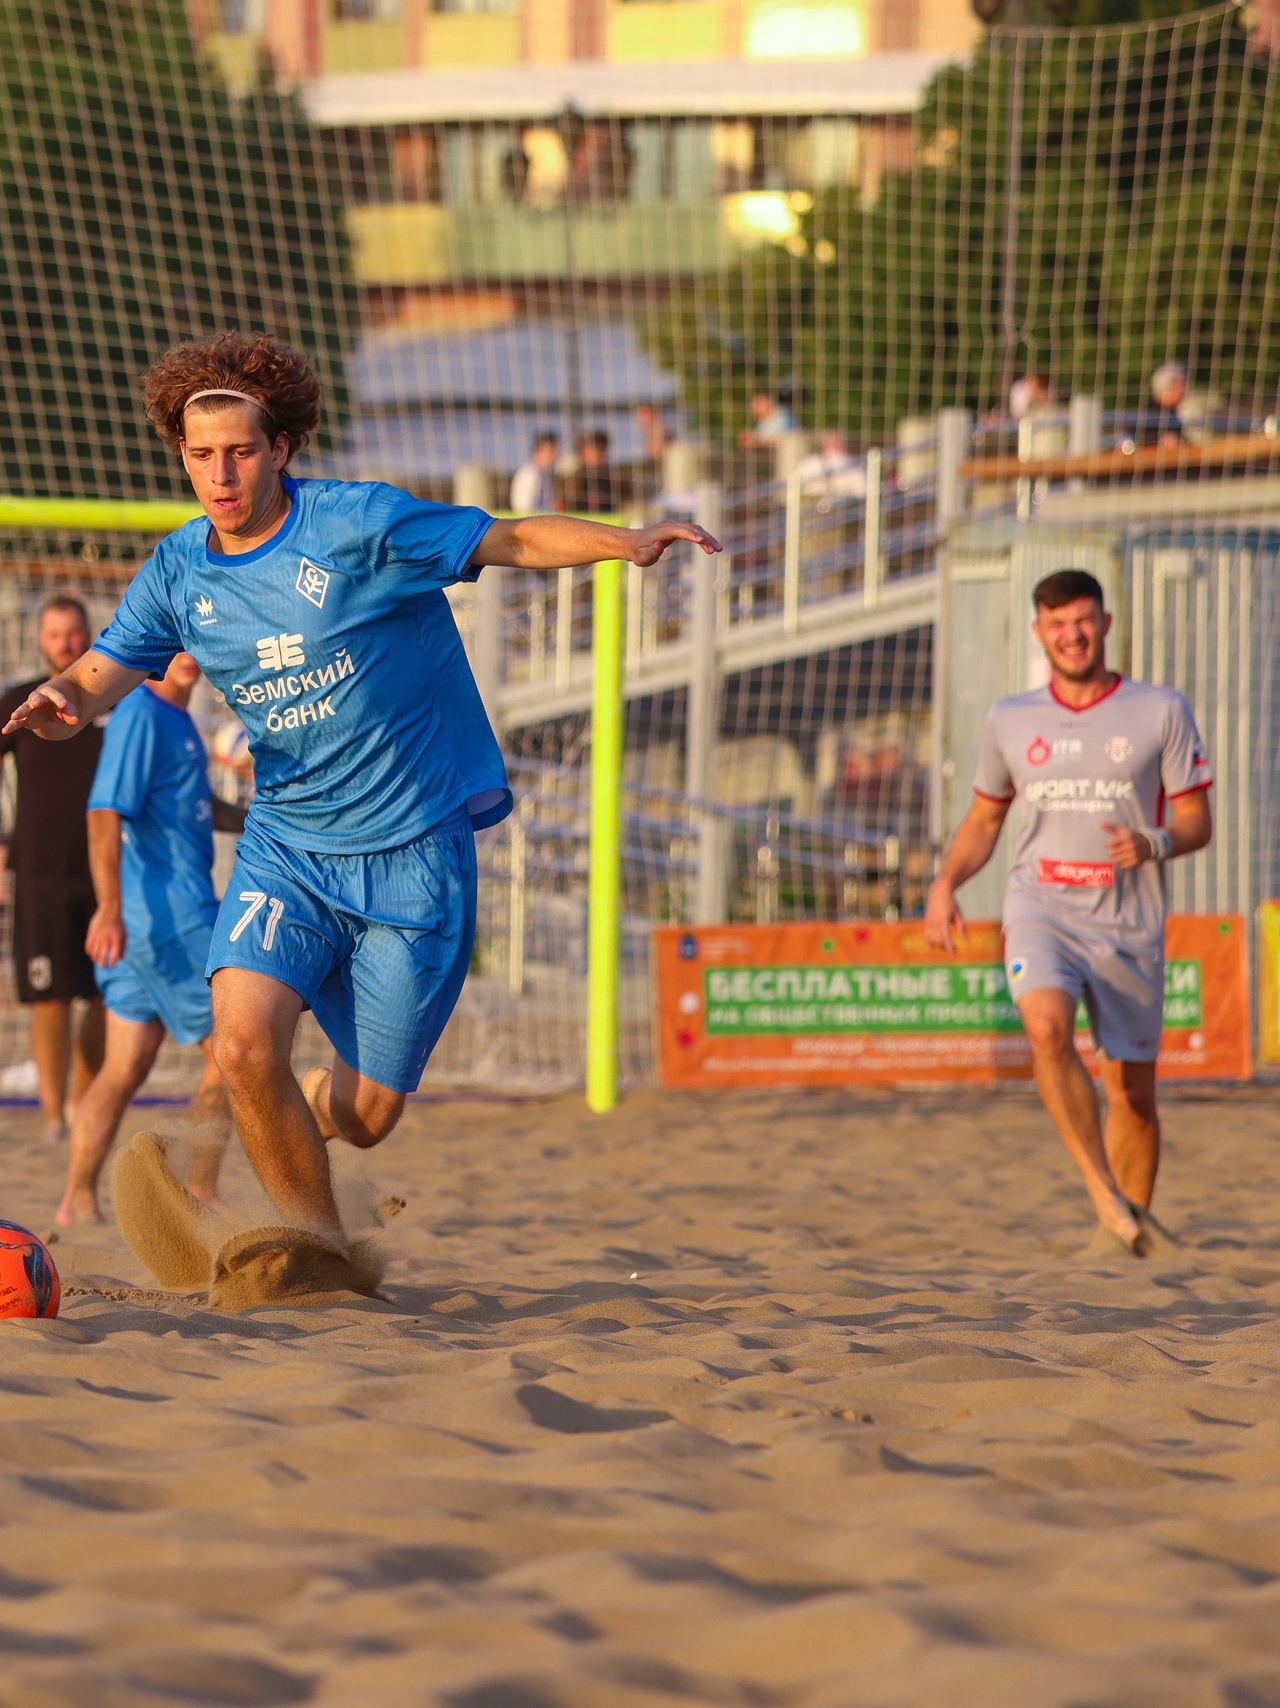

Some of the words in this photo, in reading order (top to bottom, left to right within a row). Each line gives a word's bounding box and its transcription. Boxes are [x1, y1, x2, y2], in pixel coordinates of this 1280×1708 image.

[232, 648, 355, 705] Земский
[266, 695, 336, 732] банк
[1025, 779, 1091, 802] SPORT
[1094, 780, 1134, 800] MK
[229, 891, 284, 951] 71
[709, 967, 952, 1001] БЕСПЛАТНЫЕ
